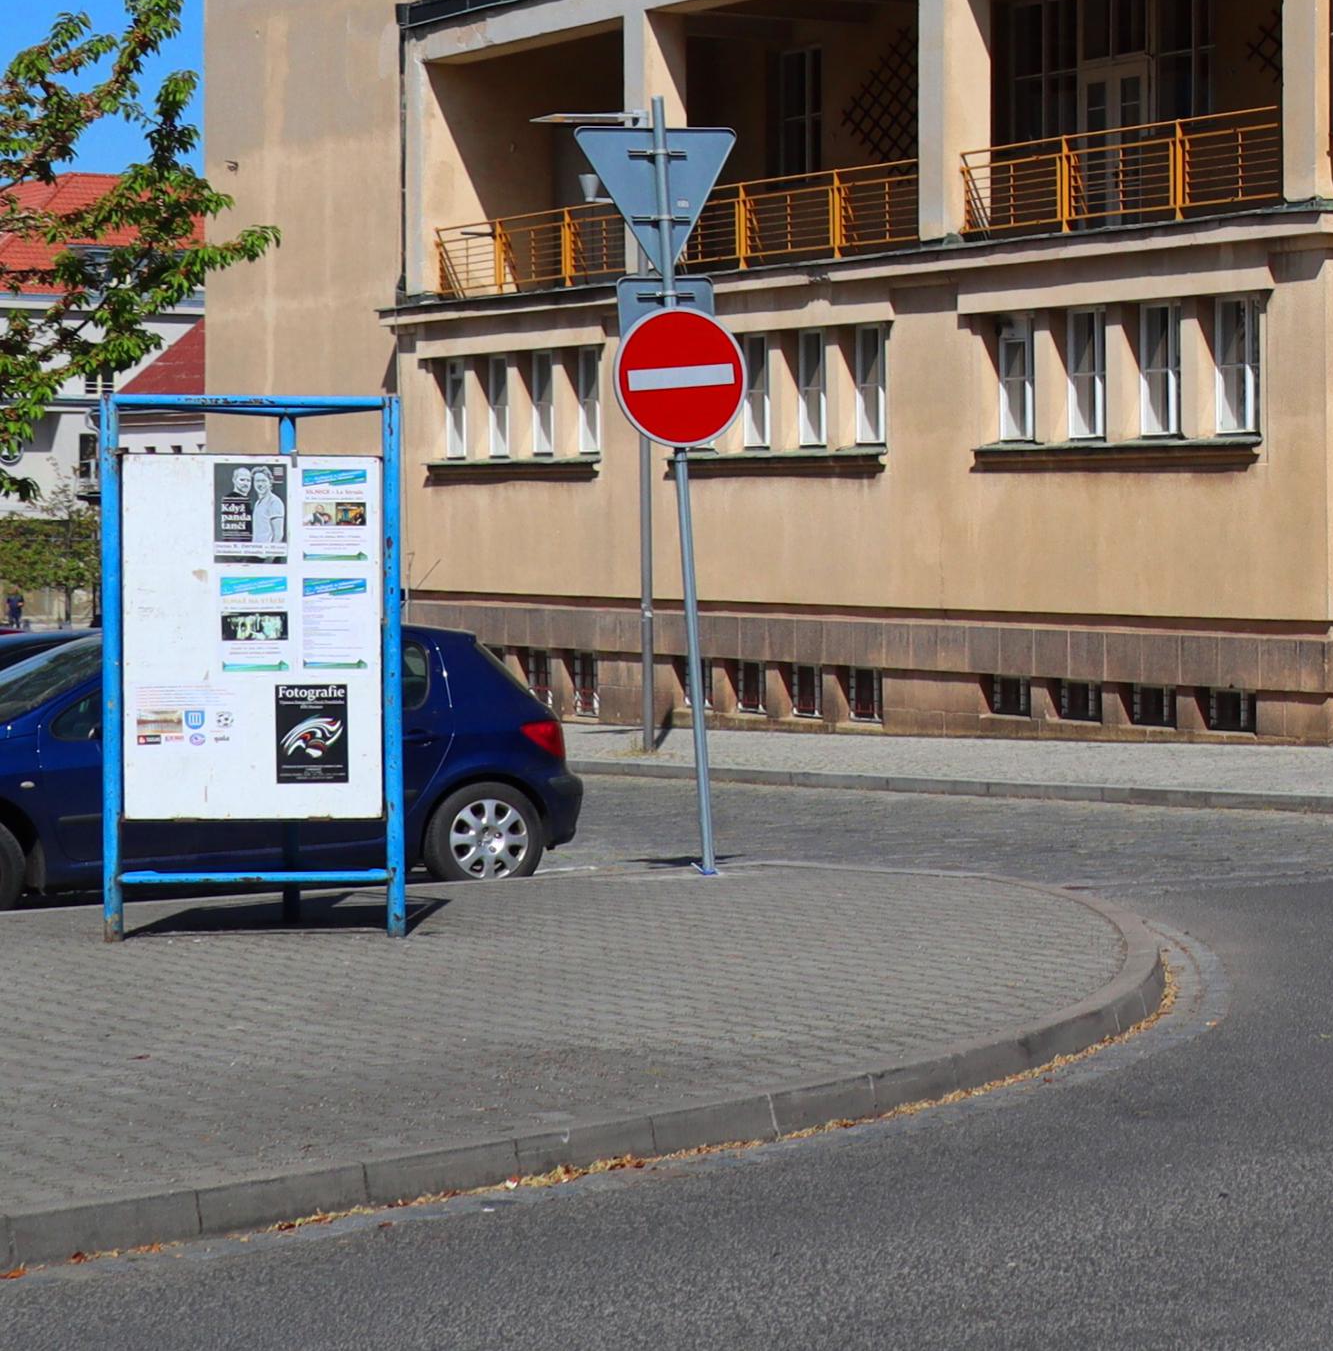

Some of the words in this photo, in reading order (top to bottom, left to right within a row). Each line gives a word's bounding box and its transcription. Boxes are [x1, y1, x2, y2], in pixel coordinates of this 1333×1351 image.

[221, 503, 246, 514] Když
[221, 512, 252, 522] panda
[221, 521, 246, 530] tančí
[278, 685, 346, 702] Fotografie
